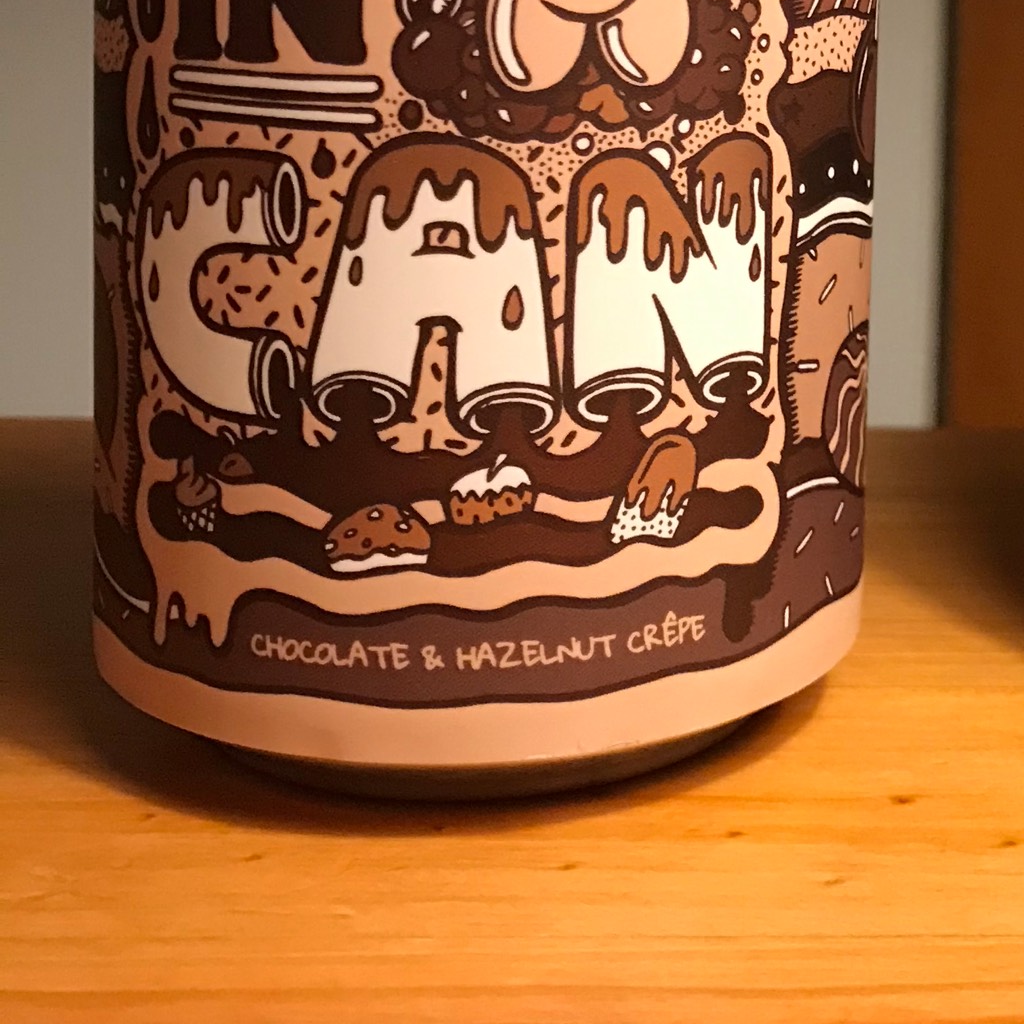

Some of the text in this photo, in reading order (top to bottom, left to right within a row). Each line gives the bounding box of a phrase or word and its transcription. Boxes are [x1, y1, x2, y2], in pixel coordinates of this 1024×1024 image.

[136, 132, 774, 440] CAN
[251, 611, 706, 671] CHOCOLATE & HAZELNUT CRÊPE
